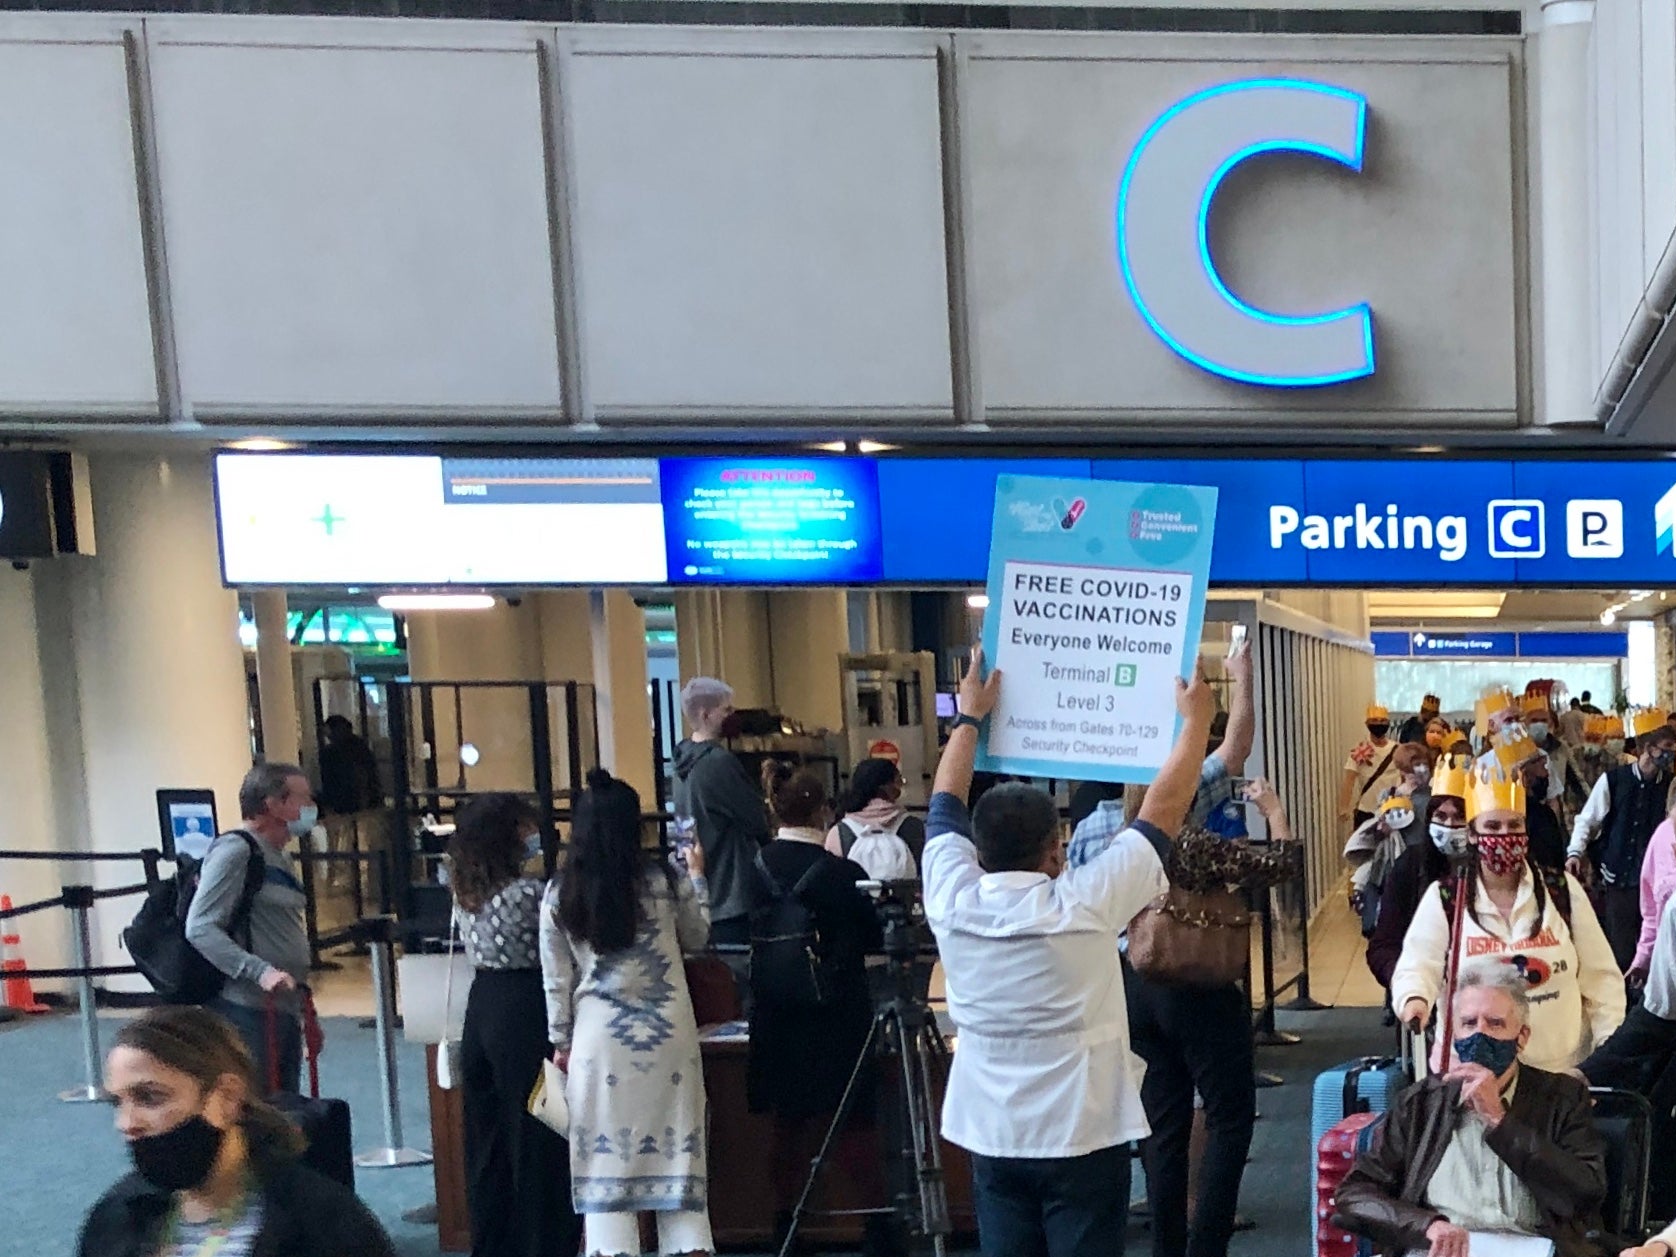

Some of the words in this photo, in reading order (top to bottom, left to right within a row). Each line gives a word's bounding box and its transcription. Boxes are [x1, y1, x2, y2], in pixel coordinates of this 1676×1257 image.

[1117, 77, 1375, 388] C
[1269, 503, 1467, 561] Parking
[1499, 510, 1532, 547] C
[1014, 574, 1073, 595] FREE
[1081, 578, 1182, 601] COVID-19
[1013, 600, 1176, 627] VACCINATIONS
[1012, 627, 1092, 651] Everyone
[1097, 634, 1172, 655] Welcome
[1042, 661, 1110, 683] Terminal
[1116, 665, 1134, 685] B
[1057, 691, 1100, 711] Level
[1105, 695, 1115, 712] 3
[1006, 715, 1047, 730] Across
[1051, 718, 1075, 732] from
[1080, 722, 1114, 735] Gates
[1118, 723, 1158, 739] 70-129
[1021, 736, 1069, 754] Security
[1073, 740, 1138, 757] Checkpoint
